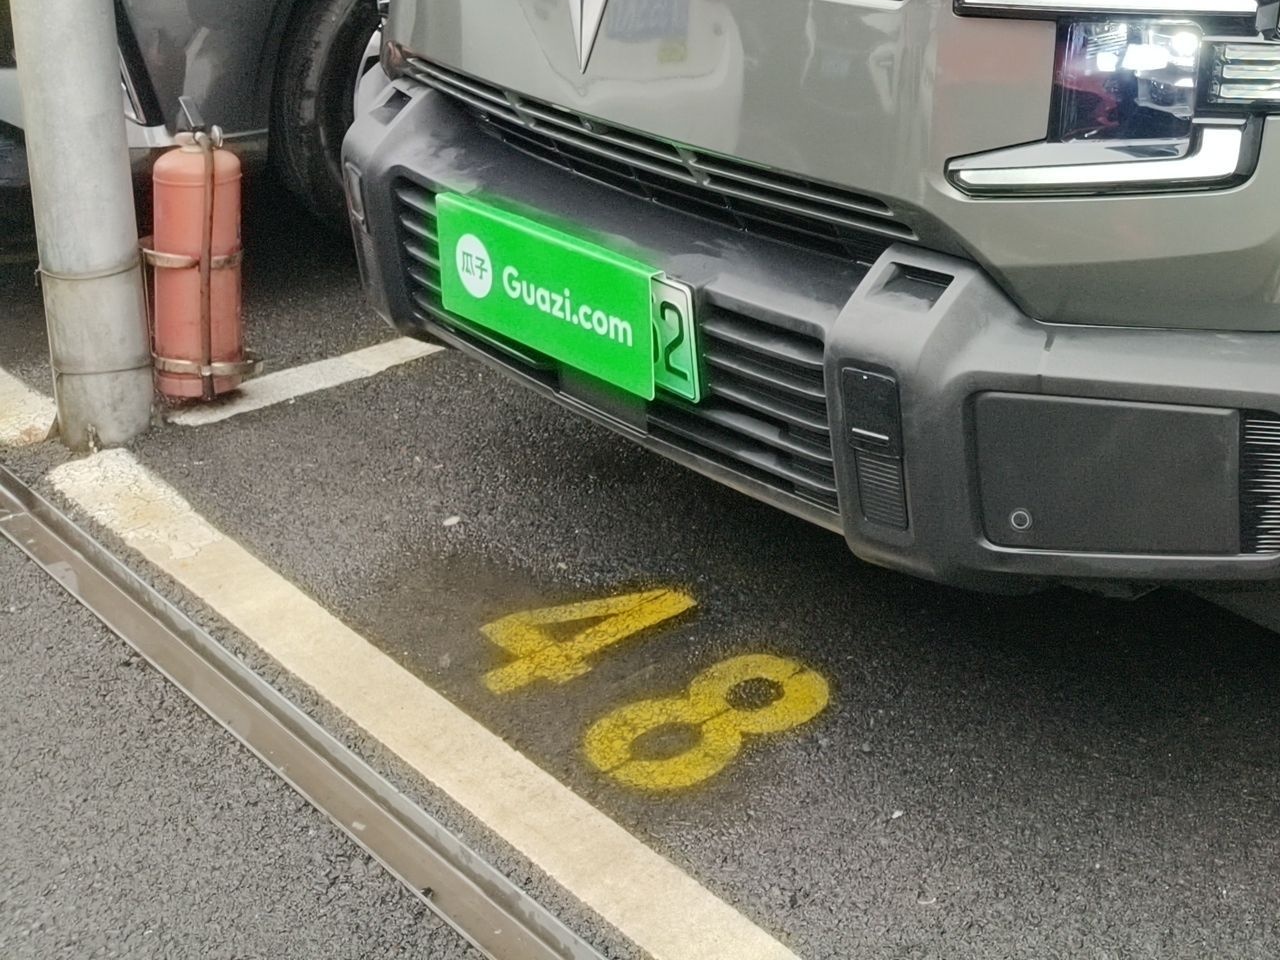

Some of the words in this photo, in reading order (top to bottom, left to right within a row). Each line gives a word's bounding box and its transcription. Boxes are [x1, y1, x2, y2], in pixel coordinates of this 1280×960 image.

[461, 252, 488, 280] 瓜子
[502, 266, 633, 347] Guazi.com
[479, 587, 830, 791] 48
